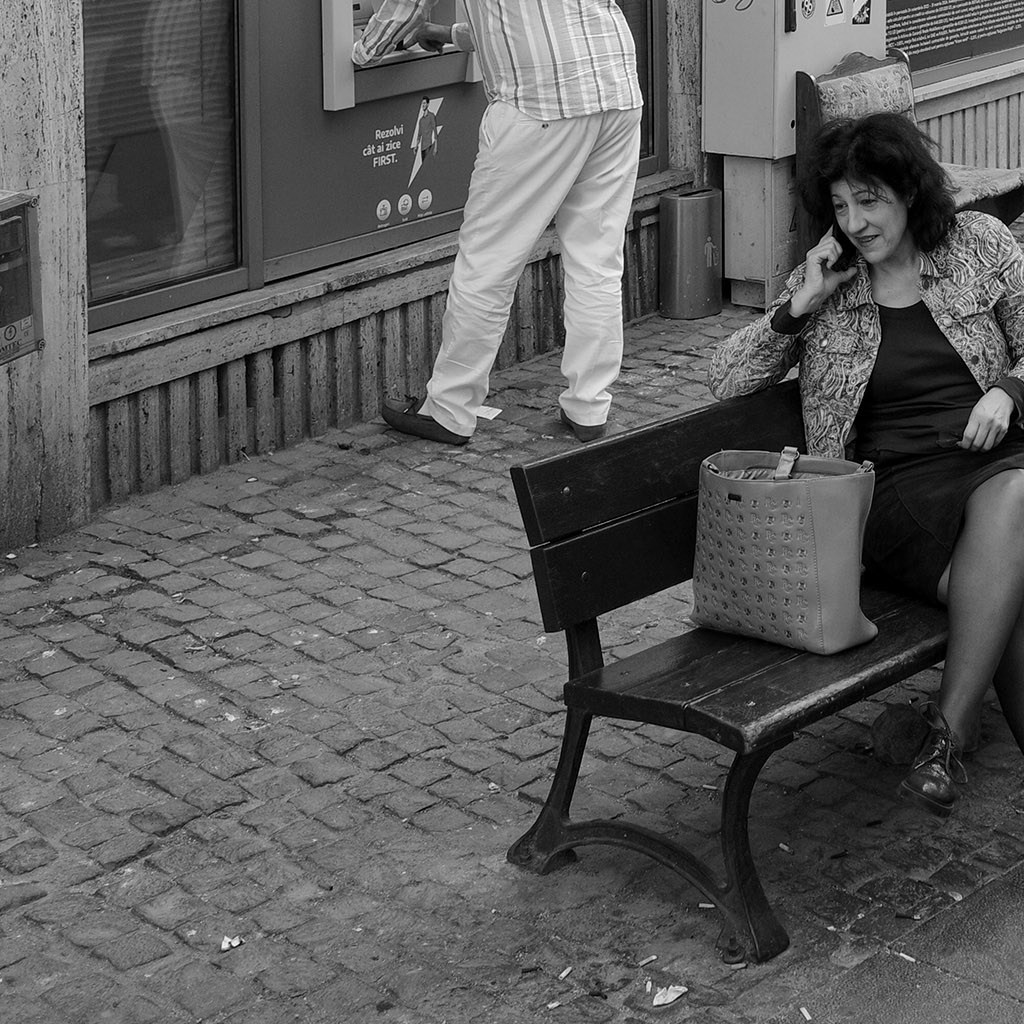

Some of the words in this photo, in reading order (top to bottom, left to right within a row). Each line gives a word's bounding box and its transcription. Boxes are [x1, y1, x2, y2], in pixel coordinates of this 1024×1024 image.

[375, 124, 404, 140] Rezolvi
[362, 144, 376, 157] cât
[377, 142, 385, 154] ai
[385, 140, 401, 152] zice
[373, 153, 398, 168] FIRST.
